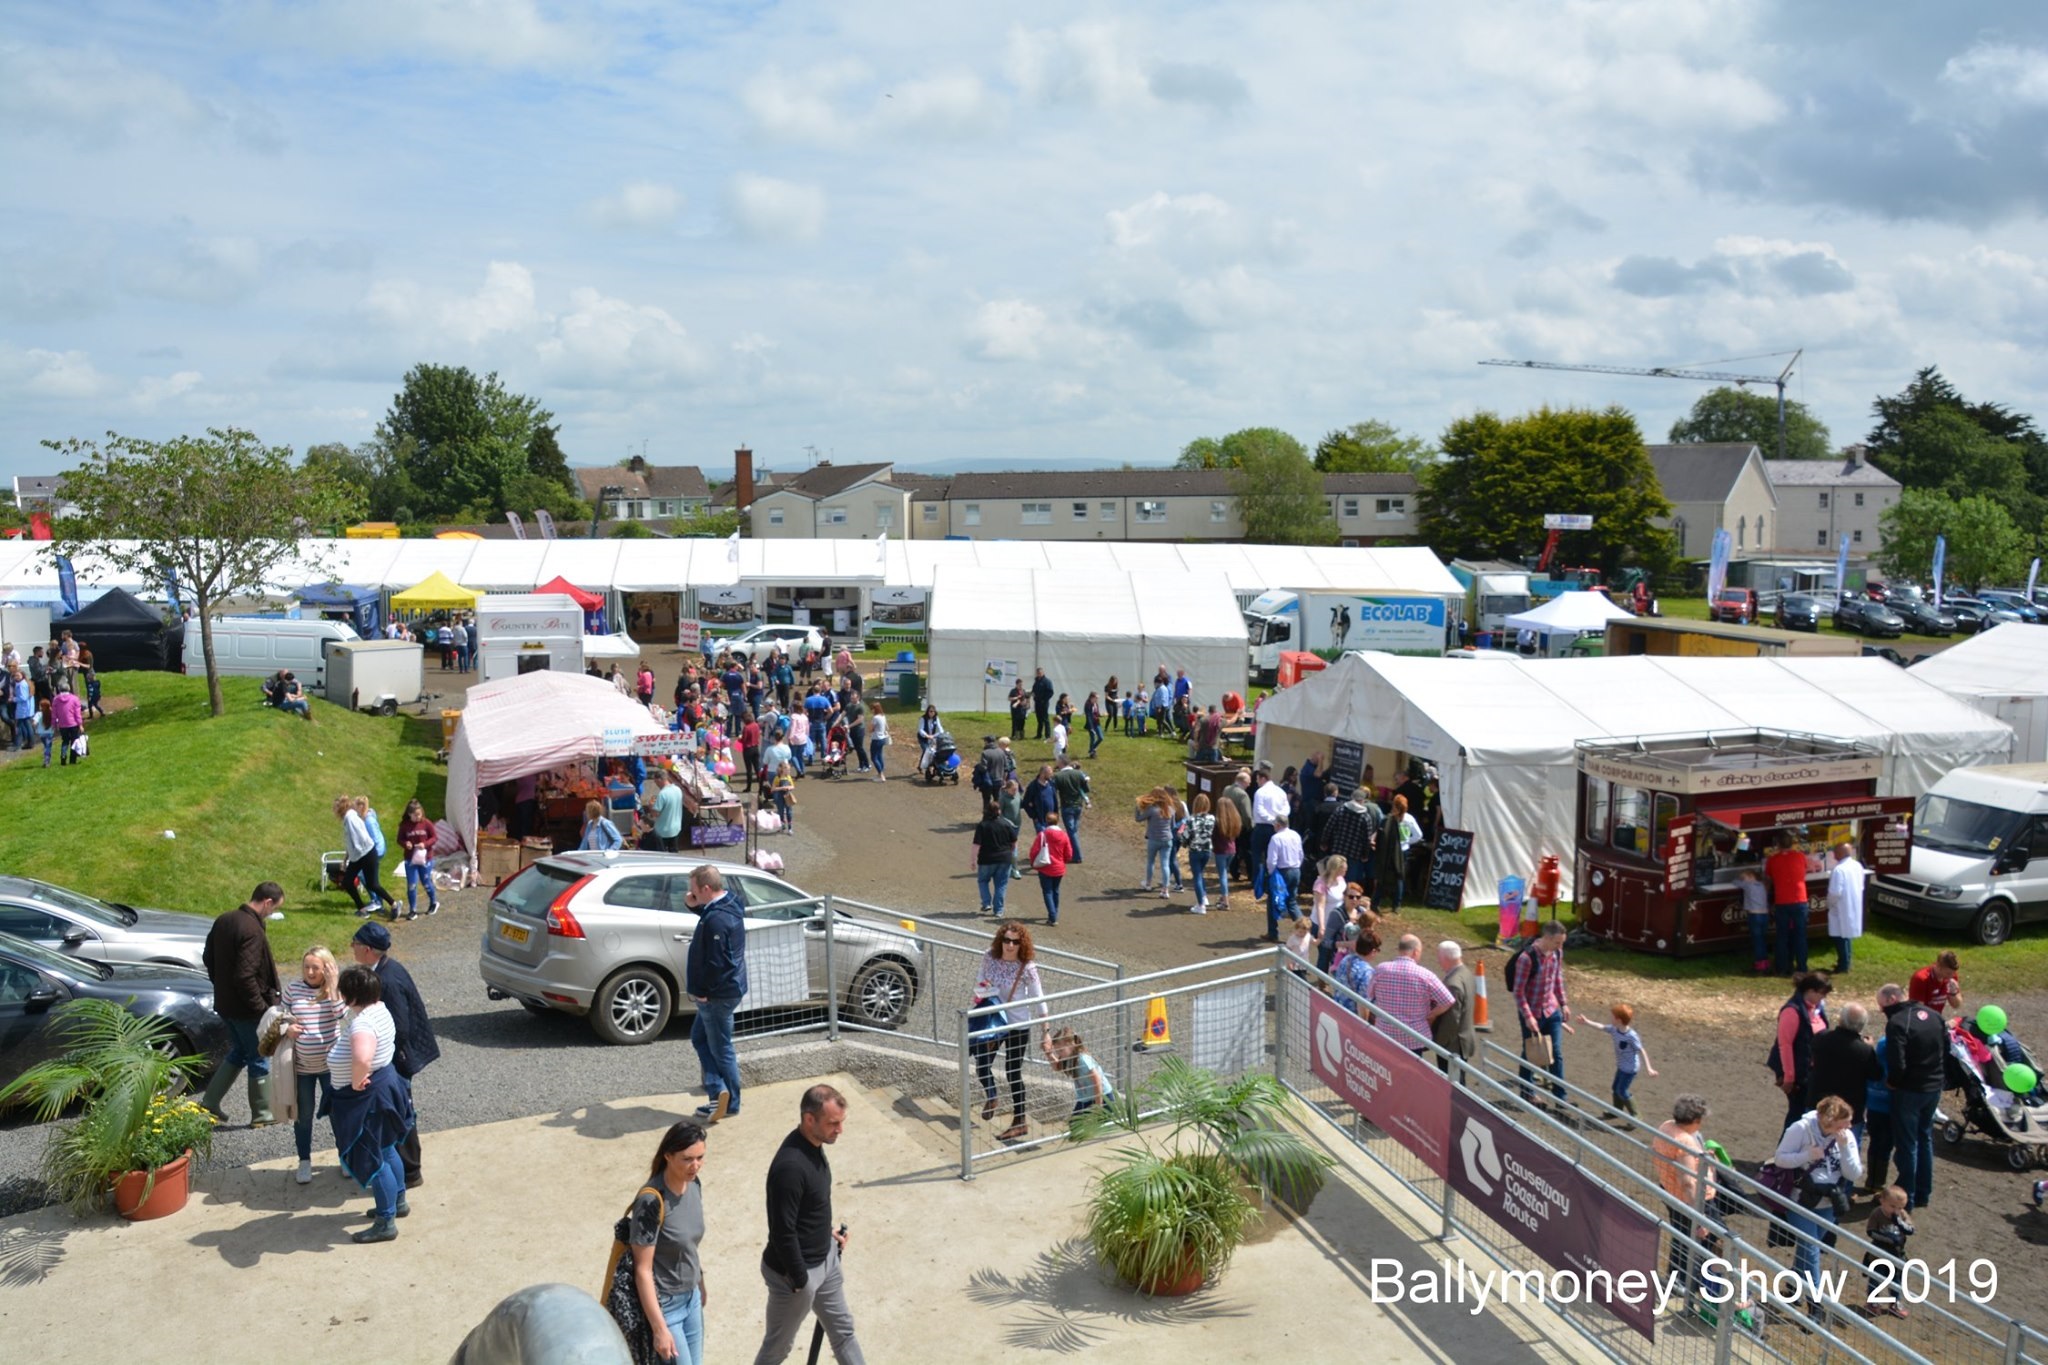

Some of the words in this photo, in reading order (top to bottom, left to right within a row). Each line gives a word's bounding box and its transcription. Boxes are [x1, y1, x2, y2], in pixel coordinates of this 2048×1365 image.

[680, 622, 699, 631] FOOD
[1361, 605, 1428, 622] ECOLAB
[636, 732, 694, 743] SWEETS
[1601, 765, 1662, 784] CORPORATION
[1776, 811, 1805, 821] DONUTS
[1813, 807, 1828, 817] HOT
[1837, 805, 1855, 815] COLD
[1856, 803, 1882, 813] DRINKS
[1344, 1038, 1392, 1086] Causeway
[1344, 1057, 1378, 1092] Coastal
[1345, 1072, 1371, 1103] Route
[1503, 1152, 1570, 1216] Causeway
[1505, 1173, 1549, 1220] Coastal
[1502, 1192, 1539, 1233] Route
